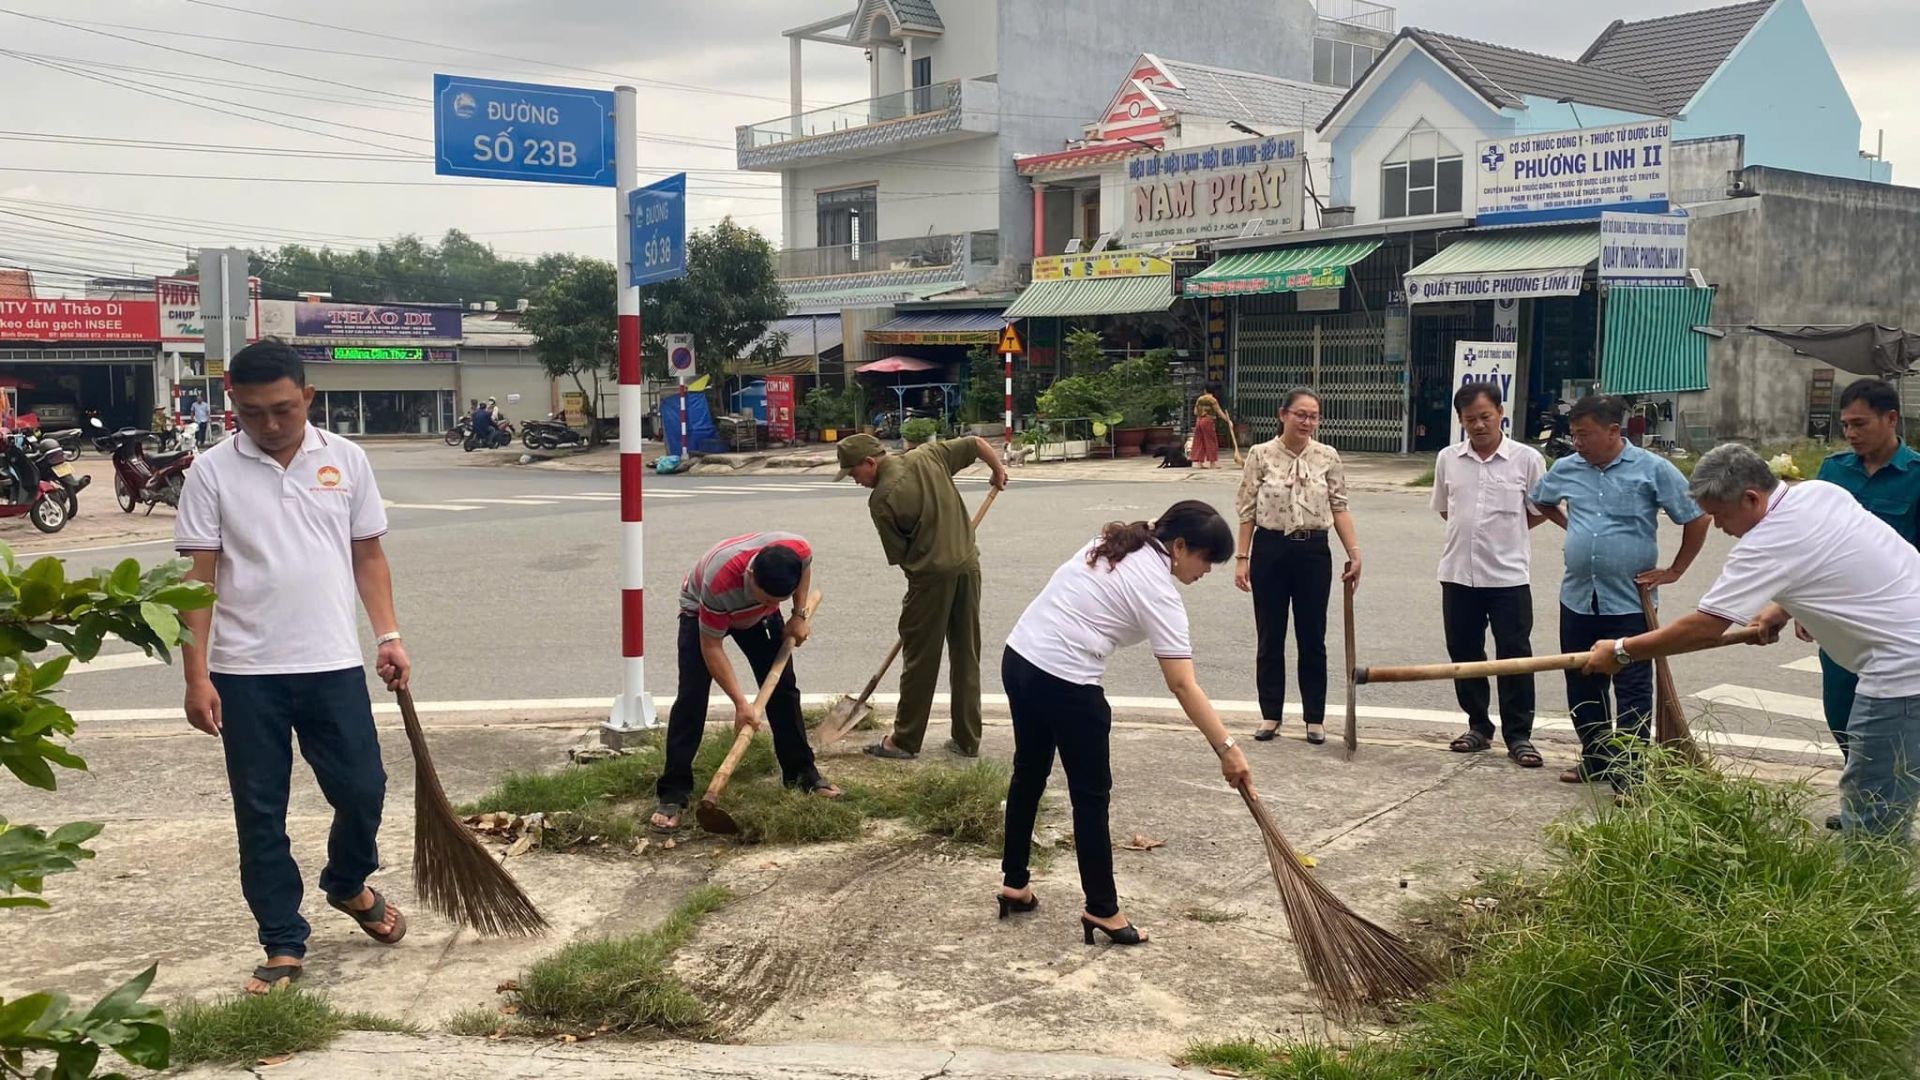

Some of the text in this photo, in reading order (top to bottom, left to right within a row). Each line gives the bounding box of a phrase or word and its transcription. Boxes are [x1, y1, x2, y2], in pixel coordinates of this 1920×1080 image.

[487, 99, 560, 125] ĐƯỜNG
[473, 127, 577, 168] SỐ 23B
[1278, 139, 1295, 159] GAS
[1532, 135, 1555, 151] THUỐC
[1556, 134, 1577, 149] ĐÔNG
[1590, 130, 1614, 145] THUỐC
[1514, 145, 1662, 180] PHƯƠNG LINH II
[1134, 165, 1286, 222] NAM PHÁT
[645, 200, 668, 225] ĐƯỜNG
[645, 228, 657, 268] SỐ
[1454, 275, 1489, 294] THUỐC
[1492, 274, 1539, 293] PHƯƠNG
[1542, 276, 1569, 290] LINH
[162, 285, 200, 306] PHOT
[32, 301, 56, 315] TM
[60, 302, 101, 316] Thảo
[328, 307, 432, 326] THẢO DI
[0, 319, 22, 328] keo
[53, 319, 82, 331] gạch
[85, 320, 122, 330] INSEE
